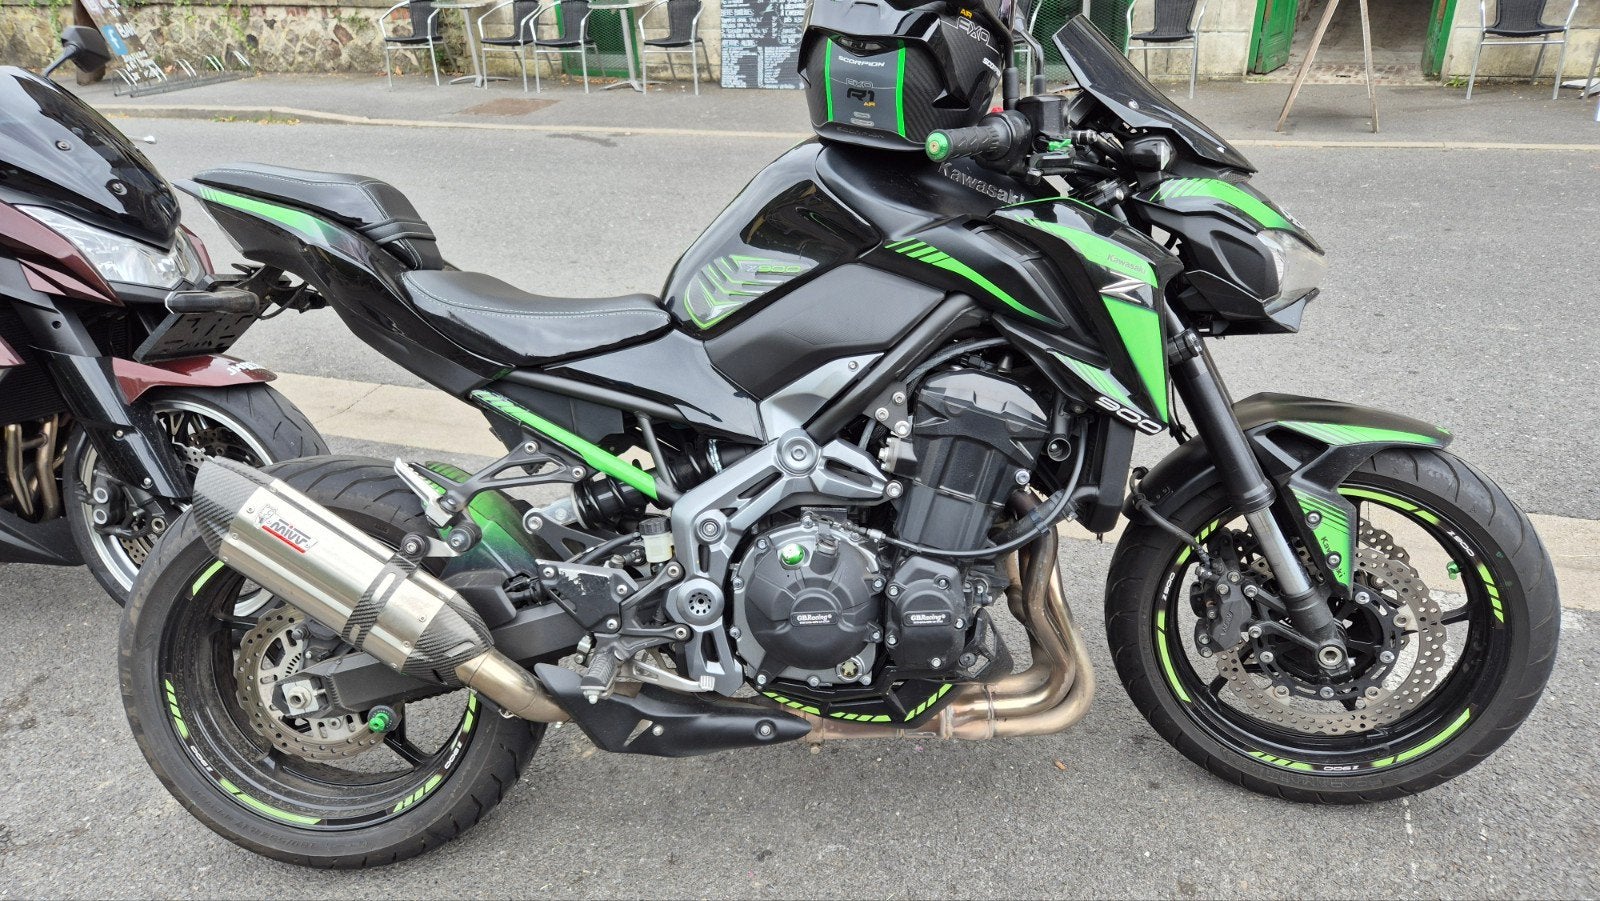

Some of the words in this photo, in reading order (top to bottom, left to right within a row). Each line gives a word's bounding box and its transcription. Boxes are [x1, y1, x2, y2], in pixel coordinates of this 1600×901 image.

[838, 55, 886, 67] SCORPION
[847, 87, 875, 102] R1
[938, 162, 1026, 206] Kawasaki
[1107, 253, 1147, 275] Kawasaki
[1095, 396, 1162, 434] 900
